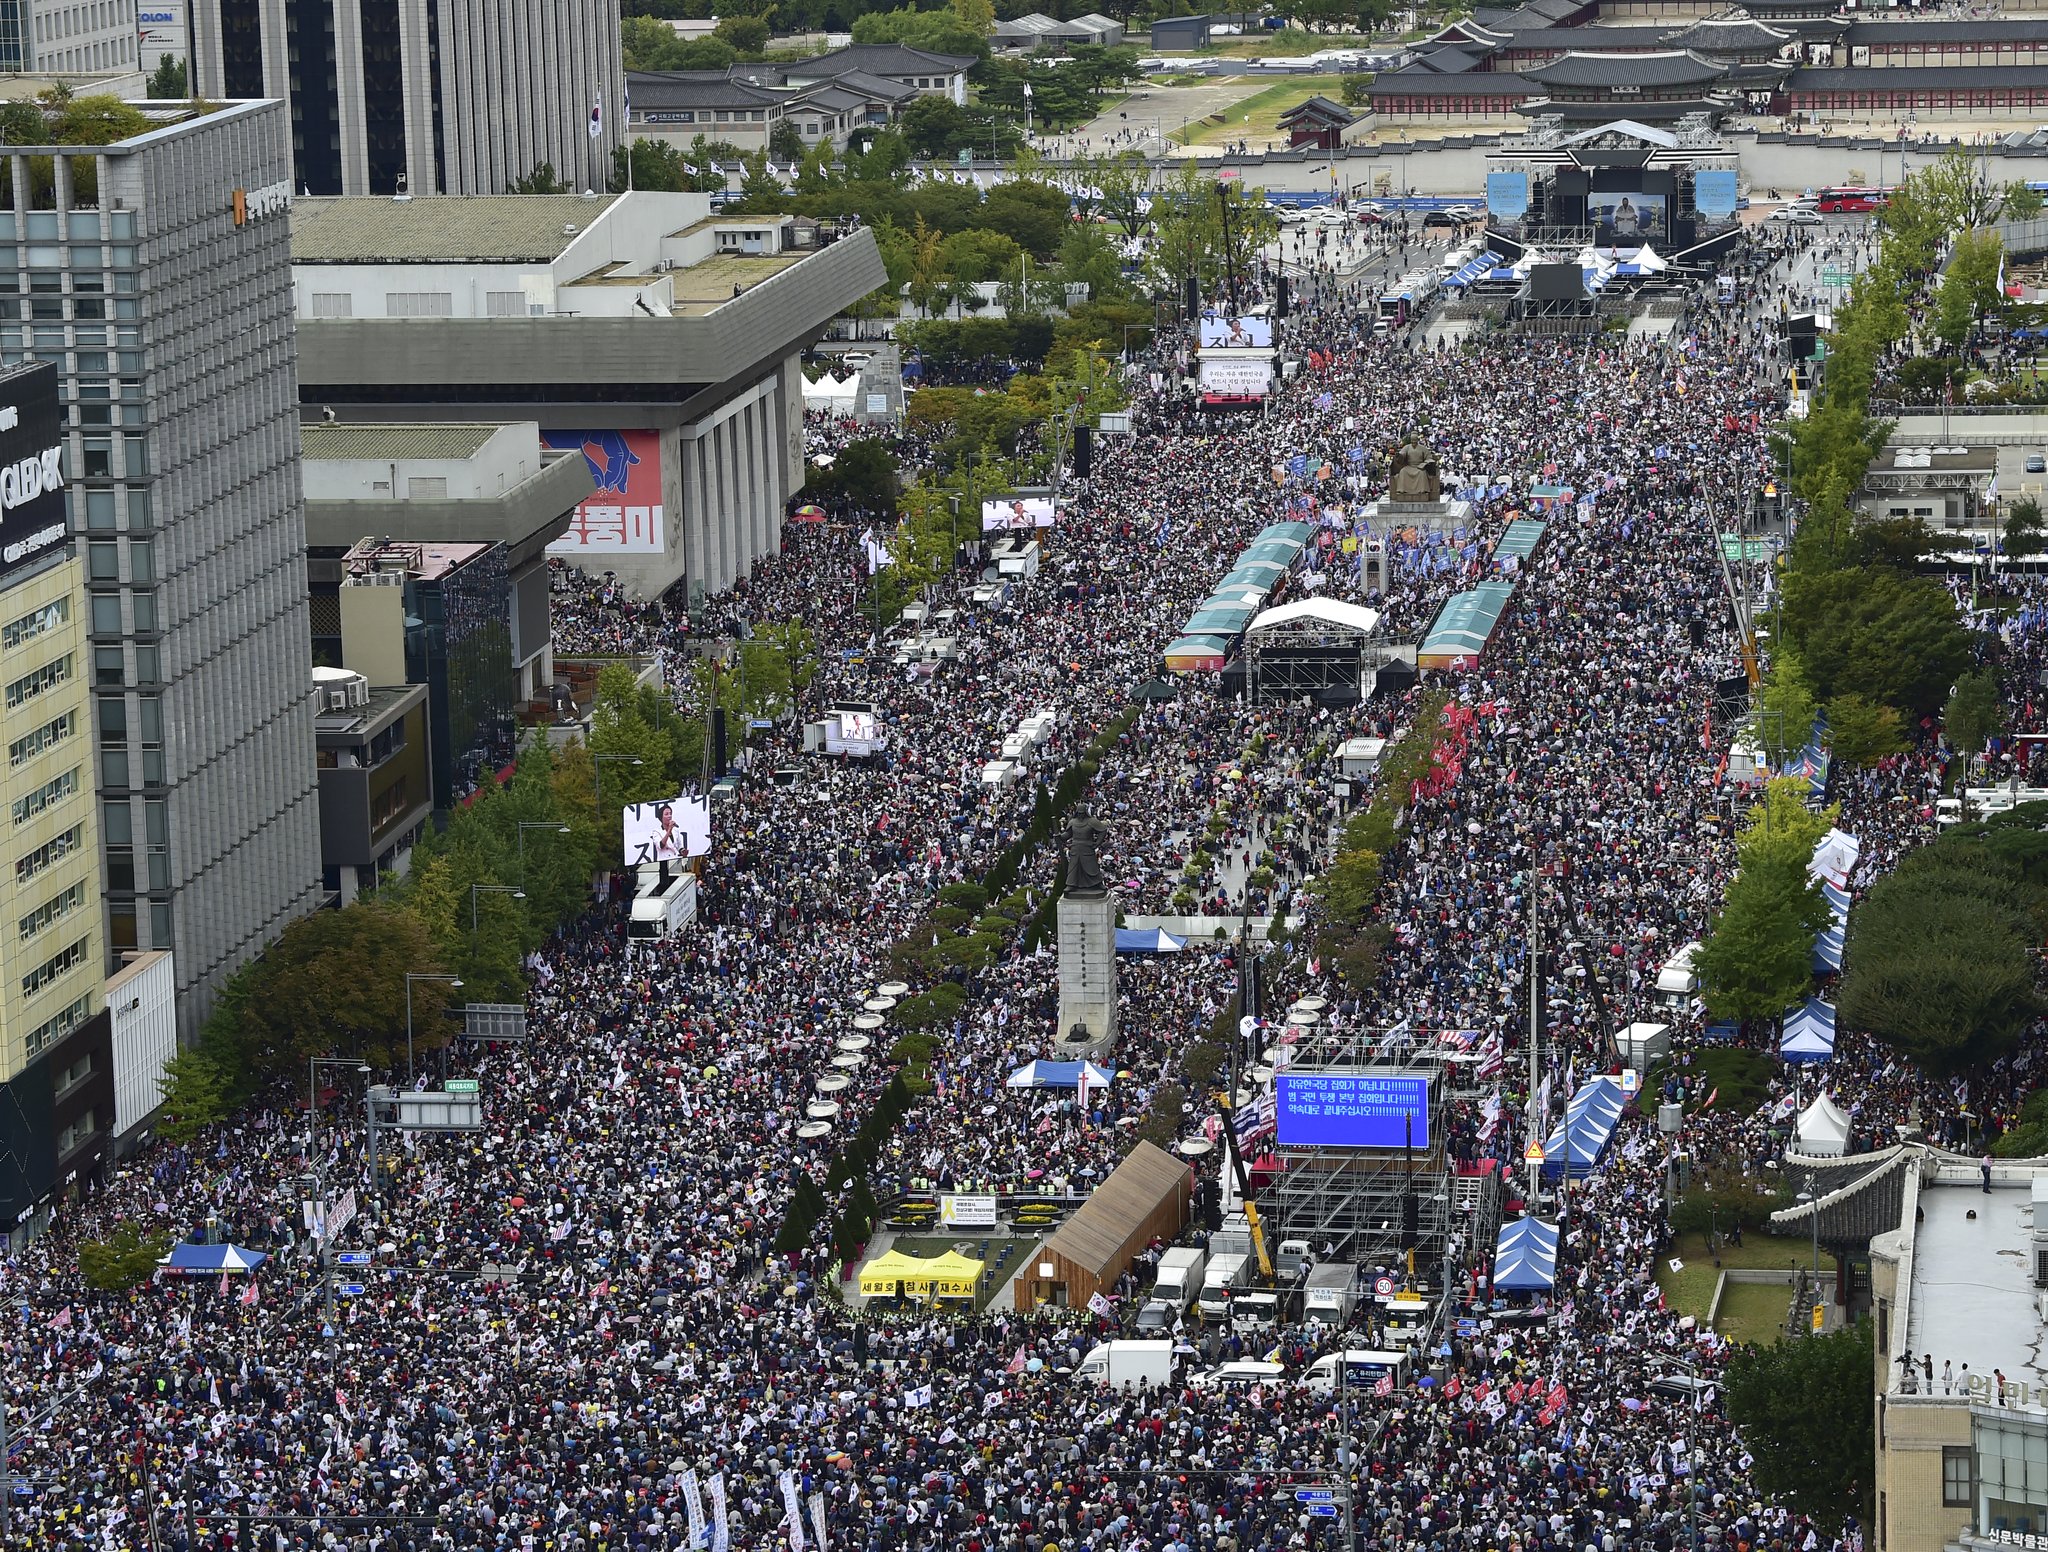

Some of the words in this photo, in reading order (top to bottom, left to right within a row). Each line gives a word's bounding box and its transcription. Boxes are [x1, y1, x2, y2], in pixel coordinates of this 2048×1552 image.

[1, 456, 43, 510] QLED
[42, 445, 65, 492] 8K
[1287, 1079, 1328, 1091] 자유한국당
[1330, 1079, 1355, 1091] 집회가
[1288, 1091, 1297, 1102] 범
[1300, 1091, 1316, 1103] 국민
[1319, 1092, 1336, 1103] 투쟁
[1339, 1092, 1355, 1103] 본부
[1287, 1104, 1320, 1115] 약속대로
[862, 1281, 895, 1293] 세월호
[905, 1281, 929, 1293] 참사
[940, 1282, 973, 1293] 재수사
[1379, 1282, 1390, 1291] 50
